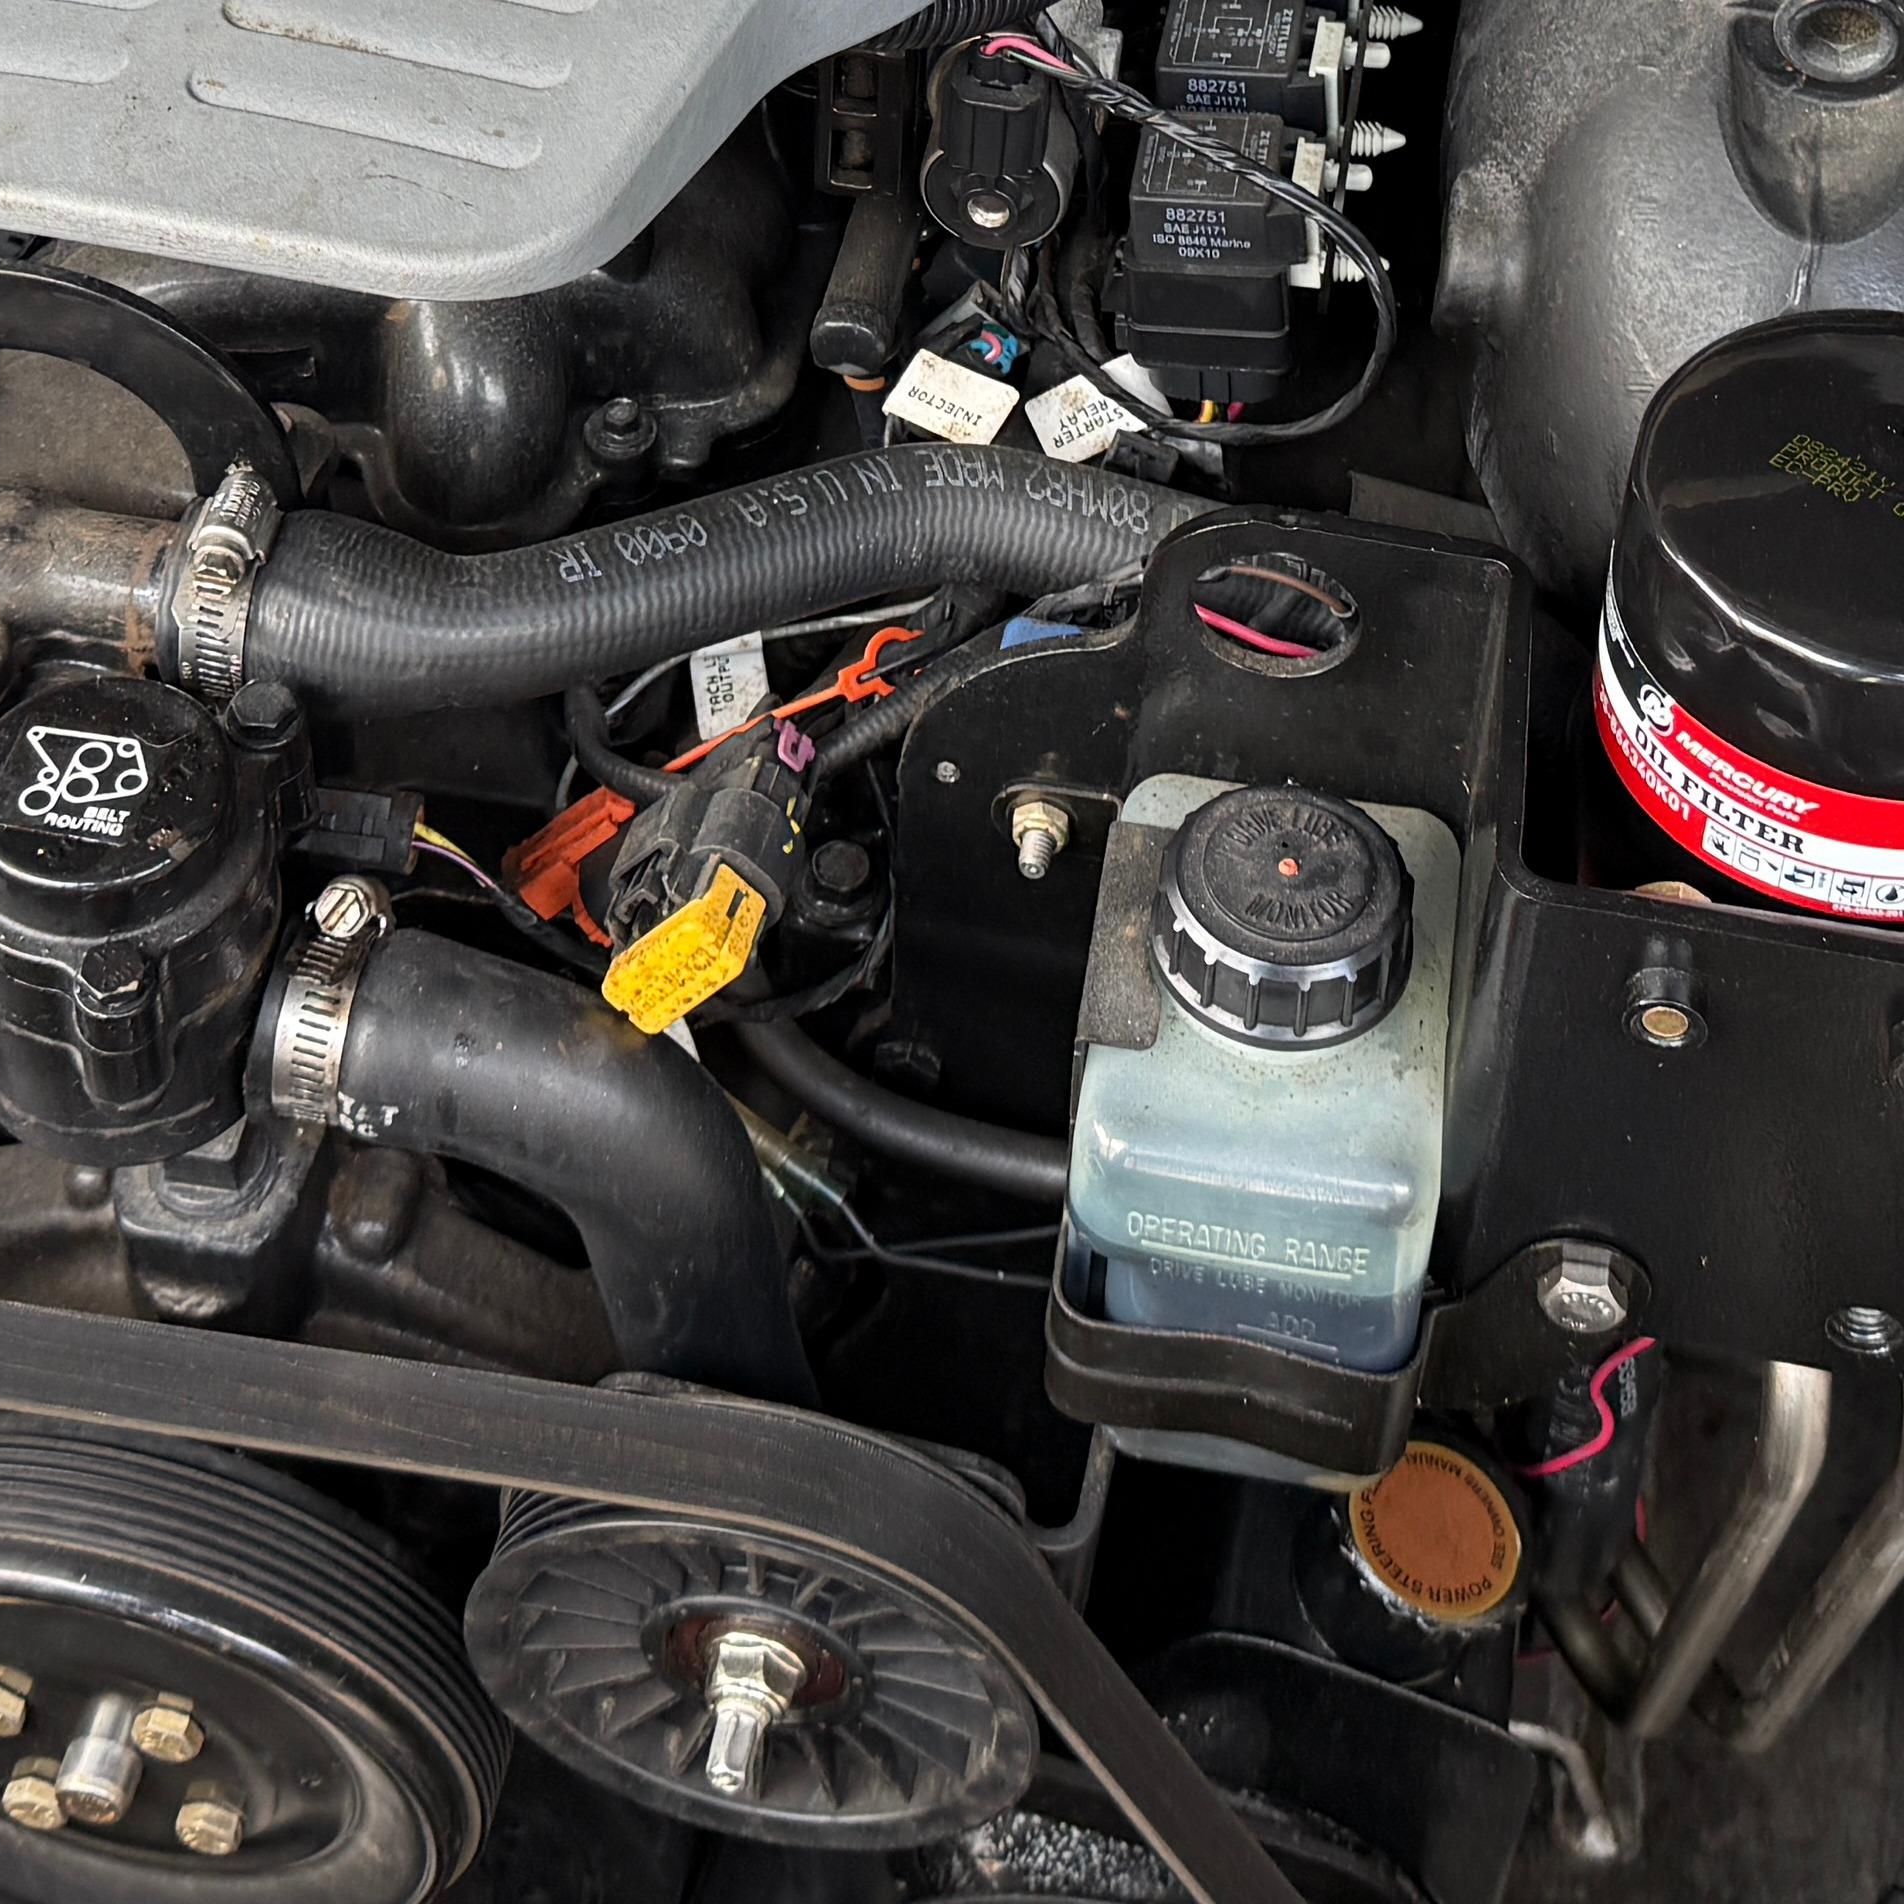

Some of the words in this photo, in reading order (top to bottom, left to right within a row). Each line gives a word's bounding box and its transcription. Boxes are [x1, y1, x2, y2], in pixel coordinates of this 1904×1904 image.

[1276, 8, 1293, 58] ZETTLER
[1186, 94, 1211, 105] SAE
[1215, 95, 1246, 108] J1171
[1188, 78, 1246, 94] 882751
[1257, 129, 1271, 167] ZETT
[1163, 222, 1189, 234] SAE
[1193, 224, 1226, 236] J1171
[1165, 207, 1225, 224] 882751
[1153, 234, 1175, 244] ISO
[1210, 237, 1251, 249] Marine
[908, 385, 983, 427] INJECTOR
[1059, 399, 1108, 431] RELAY
[1052, 407, 1124, 449] STARTER
[850, 454, 903, 495] IN
[915, 449, 1005, 493] MADE
[1780, 442, 1886, 499] PRODUCT
[706, 674, 724, 717] TACH
[1636, 724, 1673, 780] OIL
[1681, 771, 1805, 854] FILTER
[1676, 731, 1820, 815] MERCURY
[44, 811, 125, 836] ROUTING
[83, 806, 131, 823] BELT
[1245, 890, 1354, 929] MONITOR
[1127, 1210, 1266, 1260] OPERATING
[1284, 1238, 1371, 1275] RANGE
[1150, 1257, 1205, 1284] DRIVE
[1217, 1269, 1267, 1294] LUBE
[1278, 1281, 1363, 1309] MONITOR
[1266, 1310, 1316, 1341] ADD
[1360, 1509, 1424, 1595] STEERING
[1428, 1575, 1493, 1605] POWER
